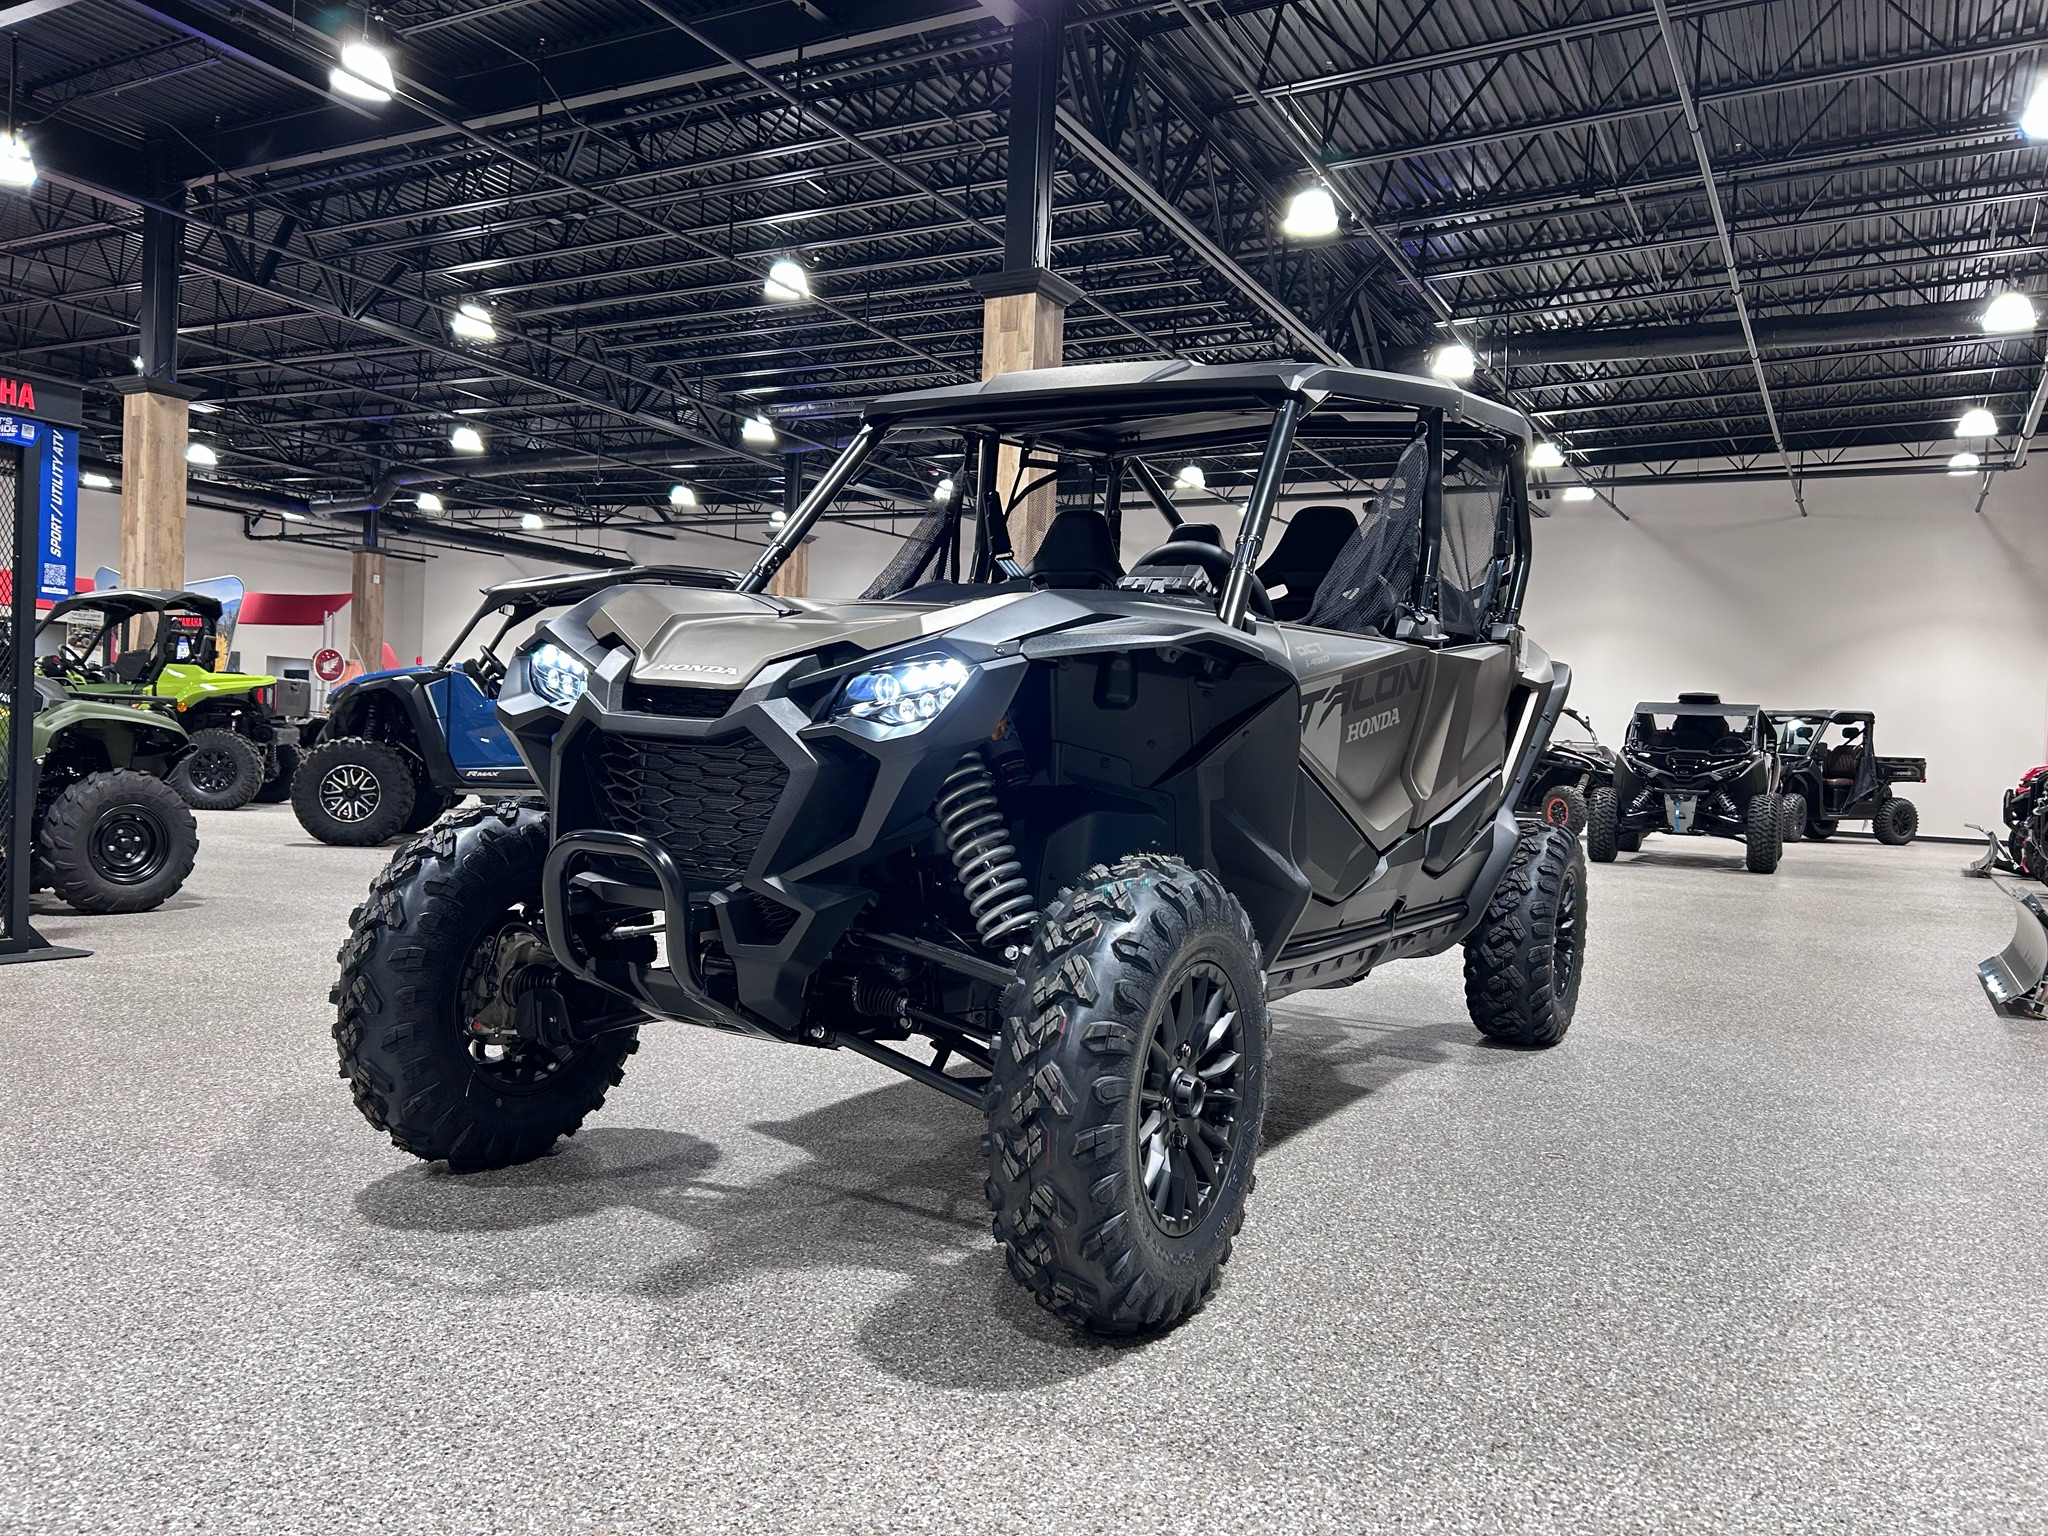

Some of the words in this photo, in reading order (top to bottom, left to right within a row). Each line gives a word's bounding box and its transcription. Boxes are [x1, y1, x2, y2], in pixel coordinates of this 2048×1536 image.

[52, 429, 65, 458] ATV
[51, 455, 64, 506] UTILITY
[50, 514, 62, 558] SPORT
[653, 663, 739, 676] HONDA
[1300, 657, 1427, 736] TALON
[1345, 707, 1400, 743] HONDA
